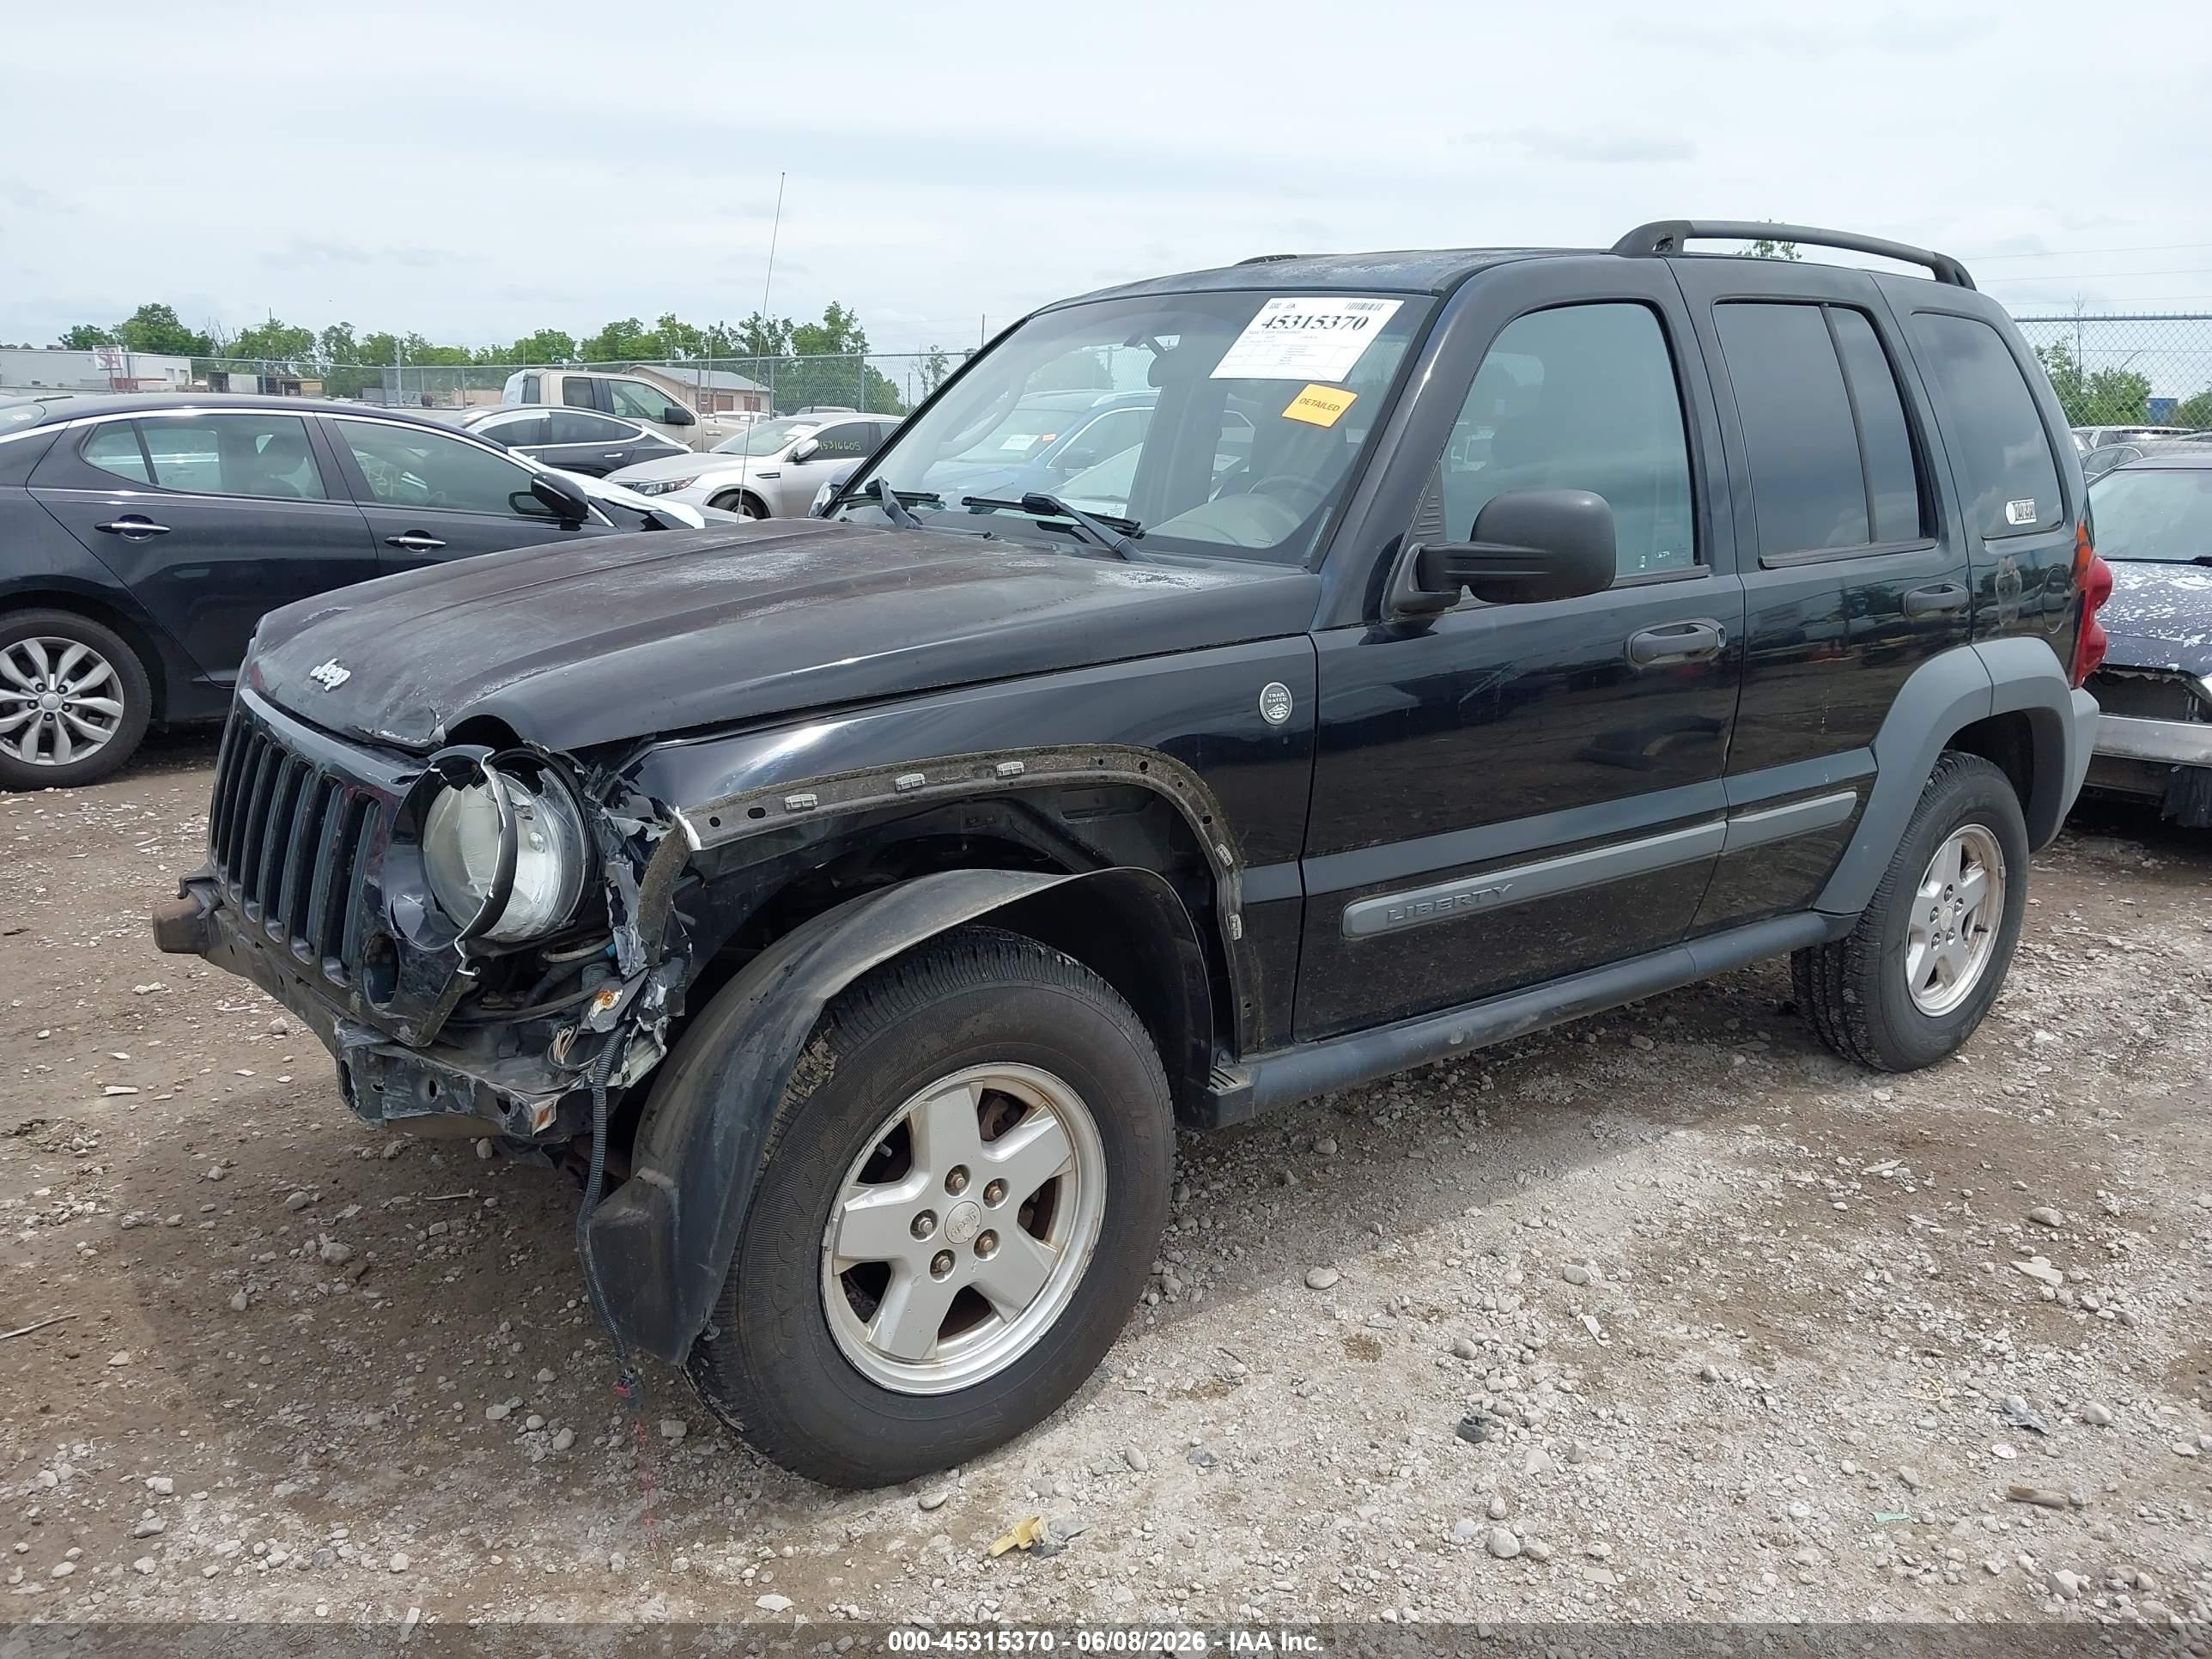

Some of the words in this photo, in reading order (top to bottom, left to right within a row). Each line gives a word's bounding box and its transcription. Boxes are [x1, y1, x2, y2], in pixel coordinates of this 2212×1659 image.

[1261, 314, 1369, 331] 45315370
[1298, 398, 1340, 412] DETAILED
[309, 658, 351, 691] Jeep
[1388, 884, 1513, 922] LIBERTY
